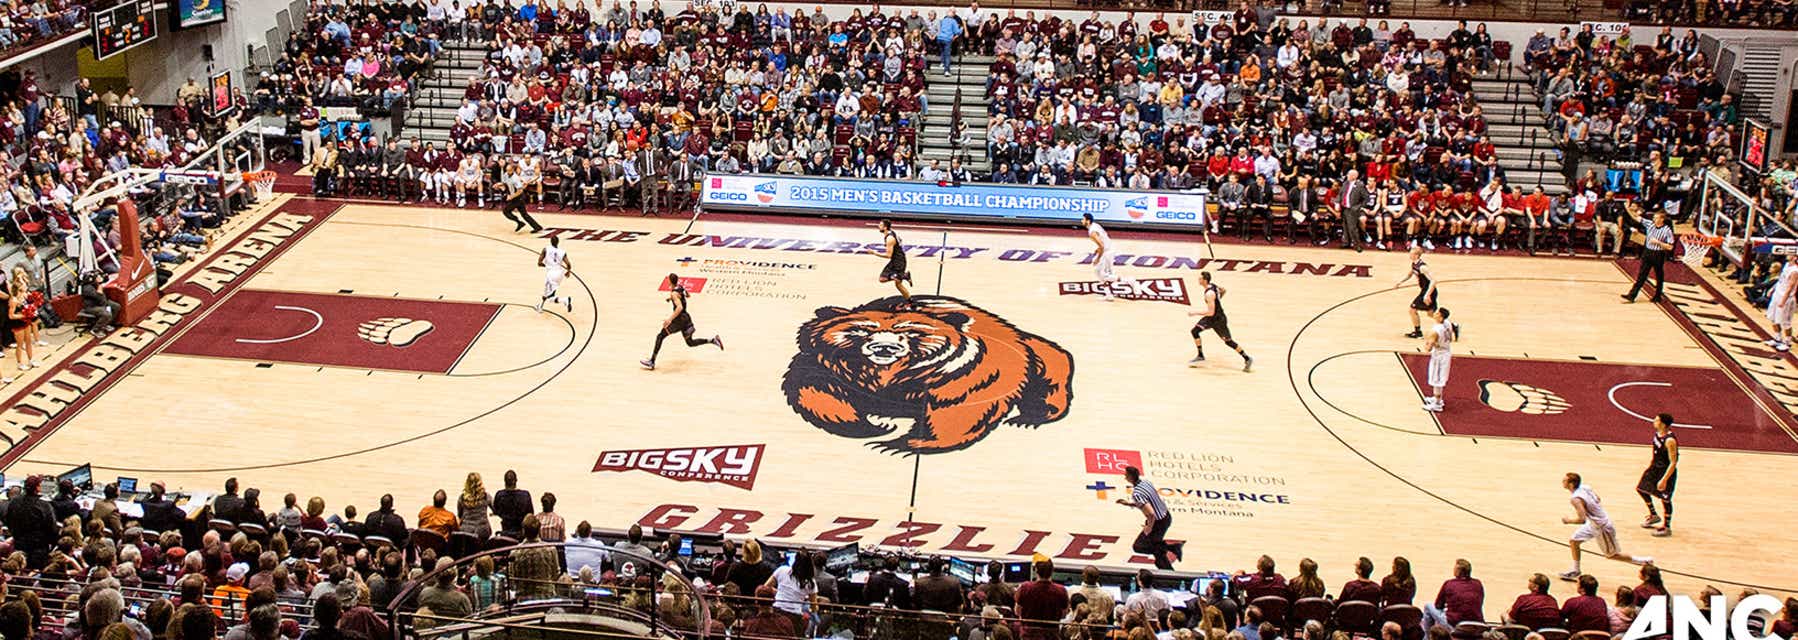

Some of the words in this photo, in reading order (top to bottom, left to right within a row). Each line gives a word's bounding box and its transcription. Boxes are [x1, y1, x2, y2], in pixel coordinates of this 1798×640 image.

[710, 191, 748, 201] GEICO
[791, 186, 828, 201] 2015
[831, 188, 878, 203] MEN'S
[881, 191, 982, 208] BASKETBALL
[985, 195, 1110, 212] CHAMPIONSHIP
[1156, 210, 1196, 220] GEICO
[537, 227, 652, 243] THE
[997, 248, 1074, 263] OF
[704, 258, 817, 271] PROVIDENCE
[0, 293, 202, 457] AHLBERG
[185, 211, 314, 296] ARENA
[1148, 451, 1184, 460] RED
[1191, 453, 1235, 464] LION
[1149, 460, 1222, 473] HOTELS
[659, 469, 751, 482] CONFERENCE
[1151, 471, 1287, 486] CORPORATION
[1191, 507, 1254, 518] Montana
